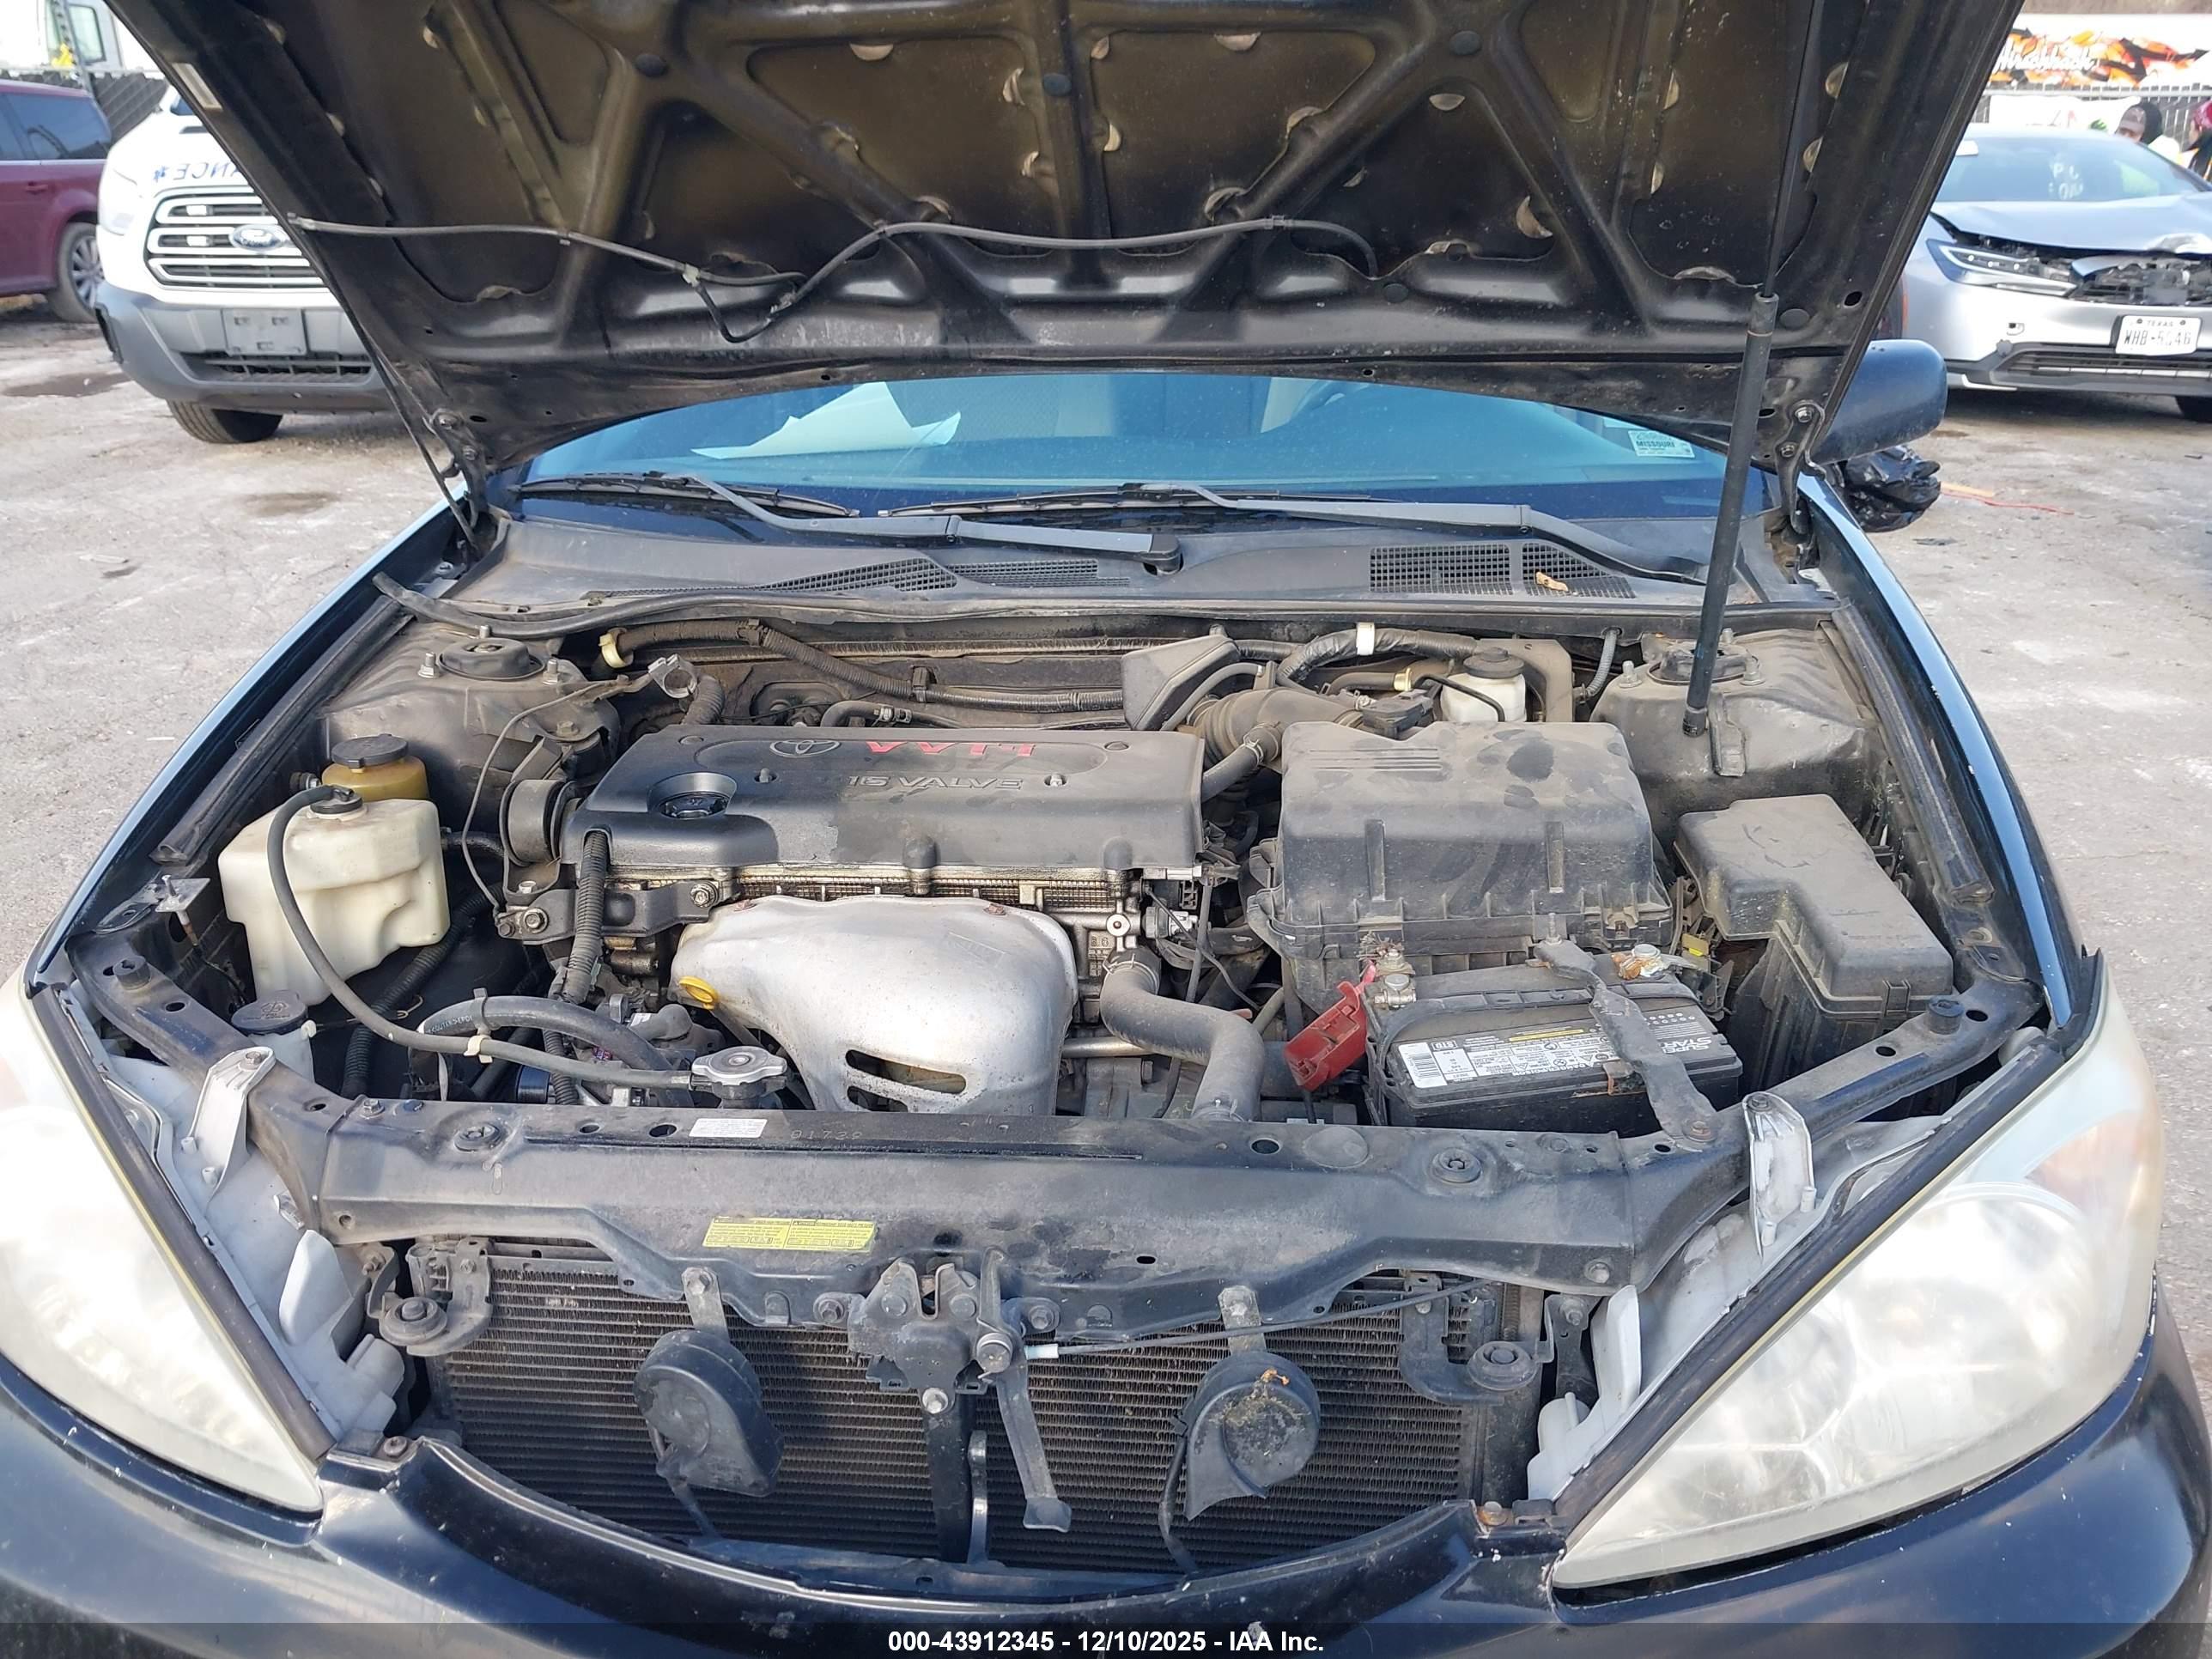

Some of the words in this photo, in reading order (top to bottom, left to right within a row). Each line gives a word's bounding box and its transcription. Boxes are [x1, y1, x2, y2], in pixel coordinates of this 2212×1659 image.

[848, 775, 890, 787] 16
[898, 775, 1024, 791] VALVE
[1658, 1036, 1712, 1048] STAR
